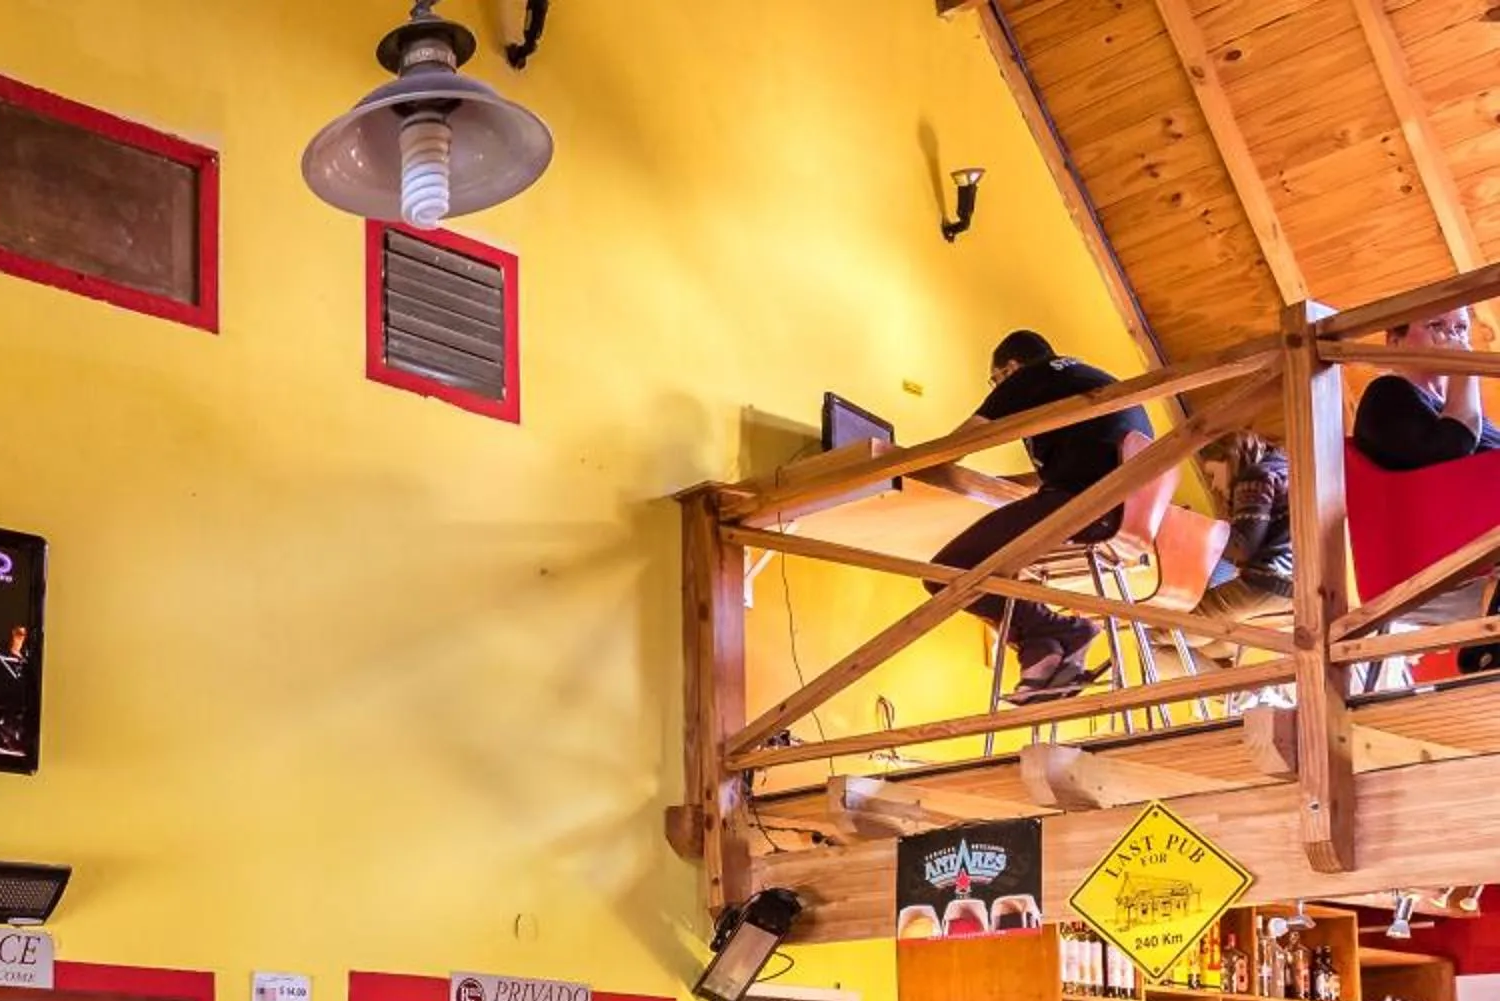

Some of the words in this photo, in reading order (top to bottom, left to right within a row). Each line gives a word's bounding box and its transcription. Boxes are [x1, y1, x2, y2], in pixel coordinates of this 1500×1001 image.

[1106, 835, 1154, 878] LAST
[1166, 834, 1205, 864] PUB
[1140, 853, 1167, 867] FOR
[1135, 936, 1159, 950] 240
[1162, 933, 1183, 945] Km
